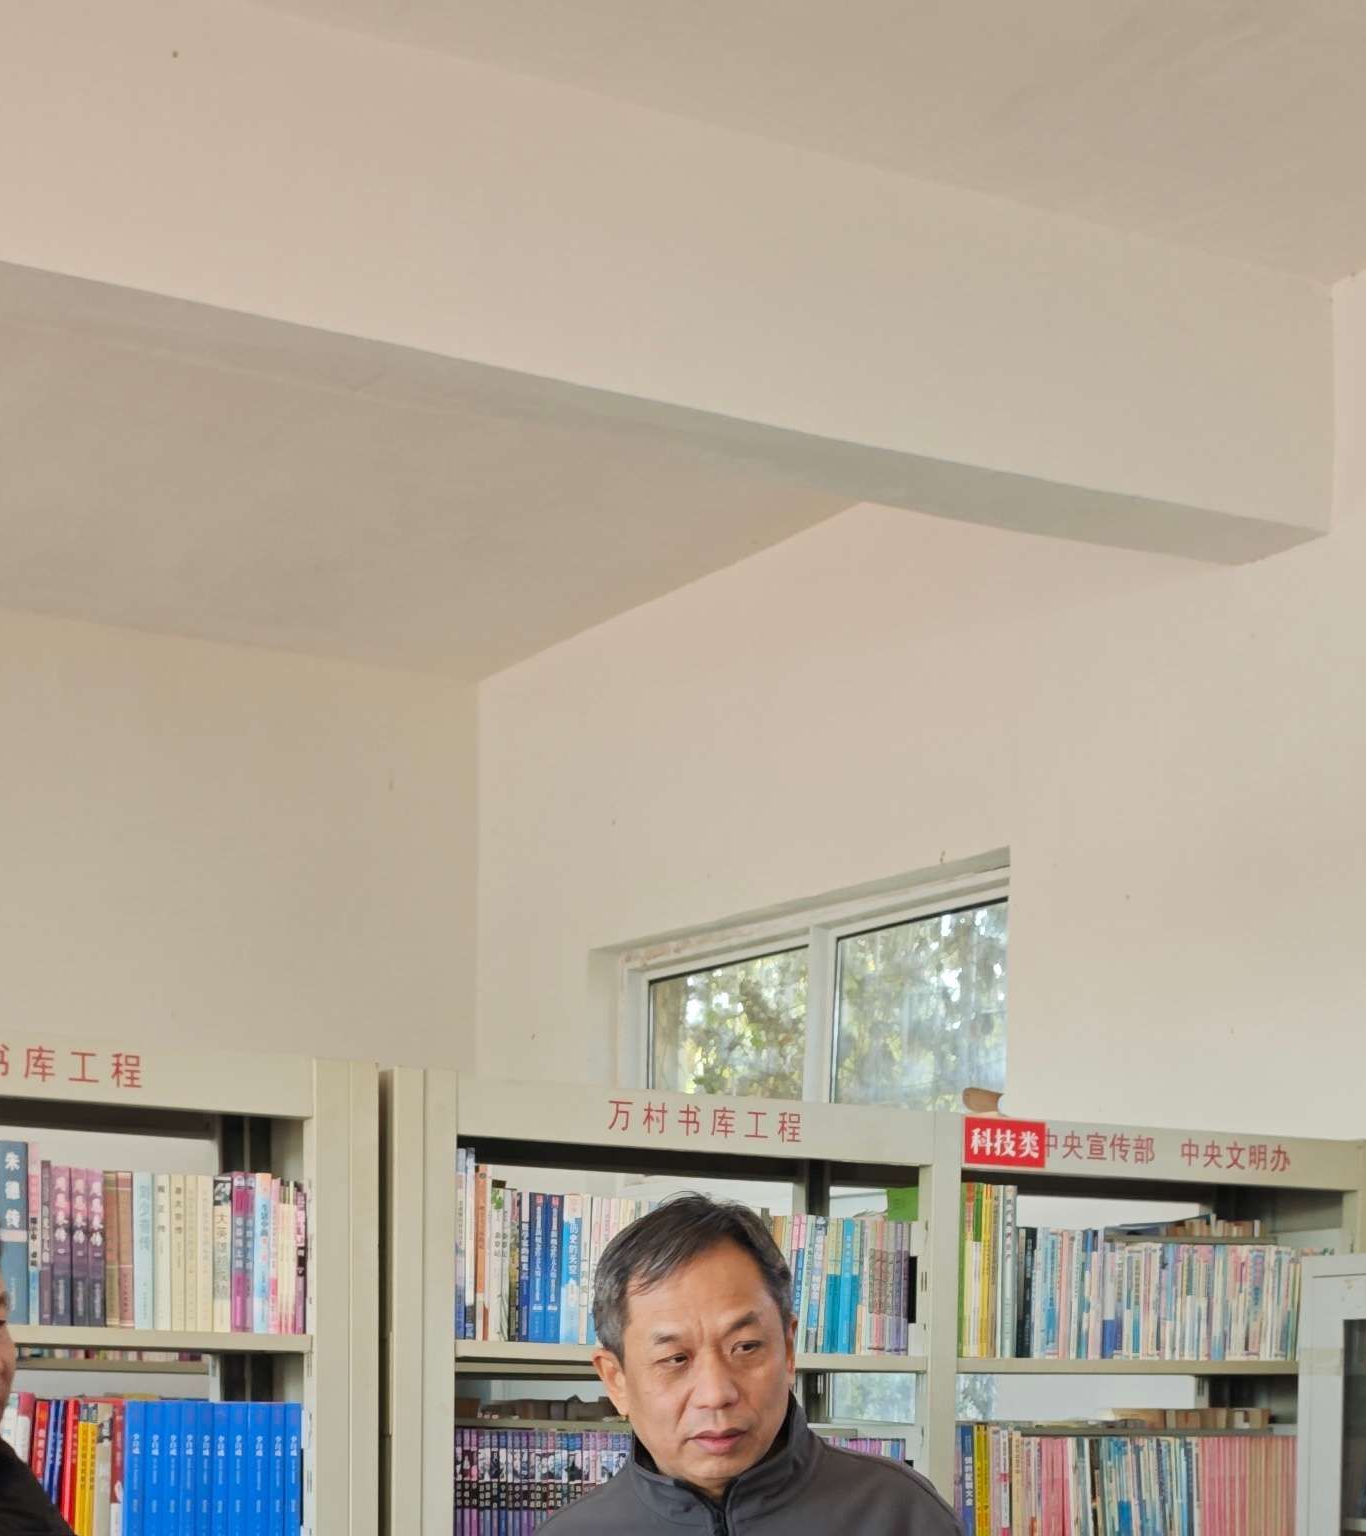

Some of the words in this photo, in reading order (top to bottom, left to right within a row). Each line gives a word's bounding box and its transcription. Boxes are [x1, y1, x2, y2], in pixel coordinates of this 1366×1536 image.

[607, 1099, 803, 1144] 万村书库工程
[969, 1127, 1041, 1159] 科技类
[1179, 1138, 1292, 1173] 中央文明办
